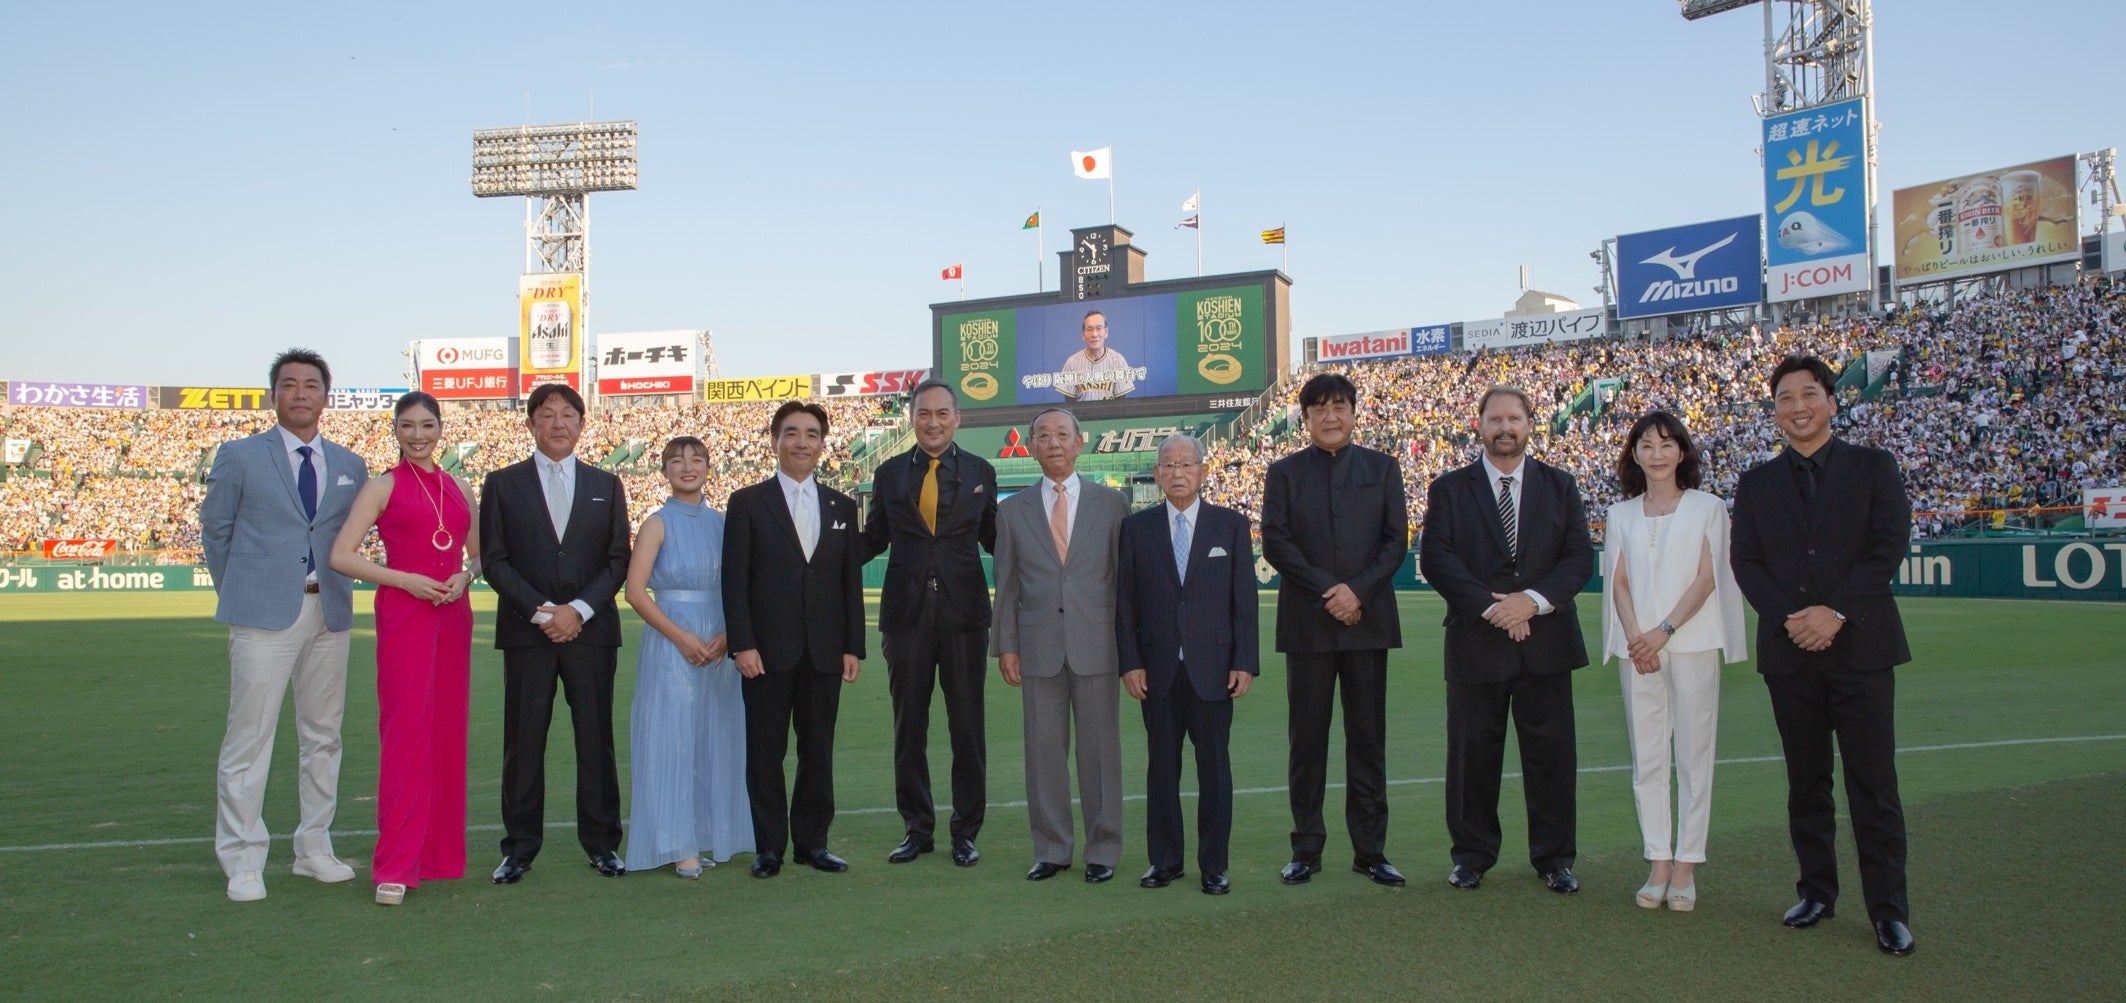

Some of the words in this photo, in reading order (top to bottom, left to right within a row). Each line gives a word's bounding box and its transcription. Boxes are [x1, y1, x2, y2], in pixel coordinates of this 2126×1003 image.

[1768, 109, 1858, 142] 超速ネット
[1774, 139, 1857, 214] 光
[1960, 210, 1981, 221] KIRIN
[1981, 206, 2001, 215] BEER
[1964, 217, 1996, 227] 一番搾り
[1938, 201, 1953, 255] 一番搾り
[1078, 264, 1110, 275] CITIZEN
[1781, 264, 1852, 295] J:COM
[1196, 297, 1242, 316] KOSHIEN
[531, 321, 569, 340] Asahi
[960, 320, 999, 337] KOSHIEN
[1197, 317, 1242, 343] 100
[1467, 328, 1500, 339] SEDIA
[1511, 312, 1604, 340] 渡辺パイプ
[1322, 331, 1407, 358] Iwatani
[1416, 328, 1445, 344] 水素
[462, 349, 504, 361] MUFG
[603, 345, 688, 366] ホーチキ
[960, 338, 999, 362] 100
[1197, 341, 1243, 353] 2024
[1416, 344, 1446, 352] エネルギー
[960, 360, 999, 371] 2024
[432, 376, 507, 390] 三菱UFJ銀行
[627, 380, 671, 391] HOCHIKI
[707, 378, 809, 399] 関西ペイント
[860, 371, 925, 393] SSK
[16, 382, 140, 407] わかさ生活
[179, 388, 266, 409] ZETT
[1209, 397, 1259, 409] 三井住友銀行
[57, 570, 86, 589] at
[88, 566, 164, 589] home
